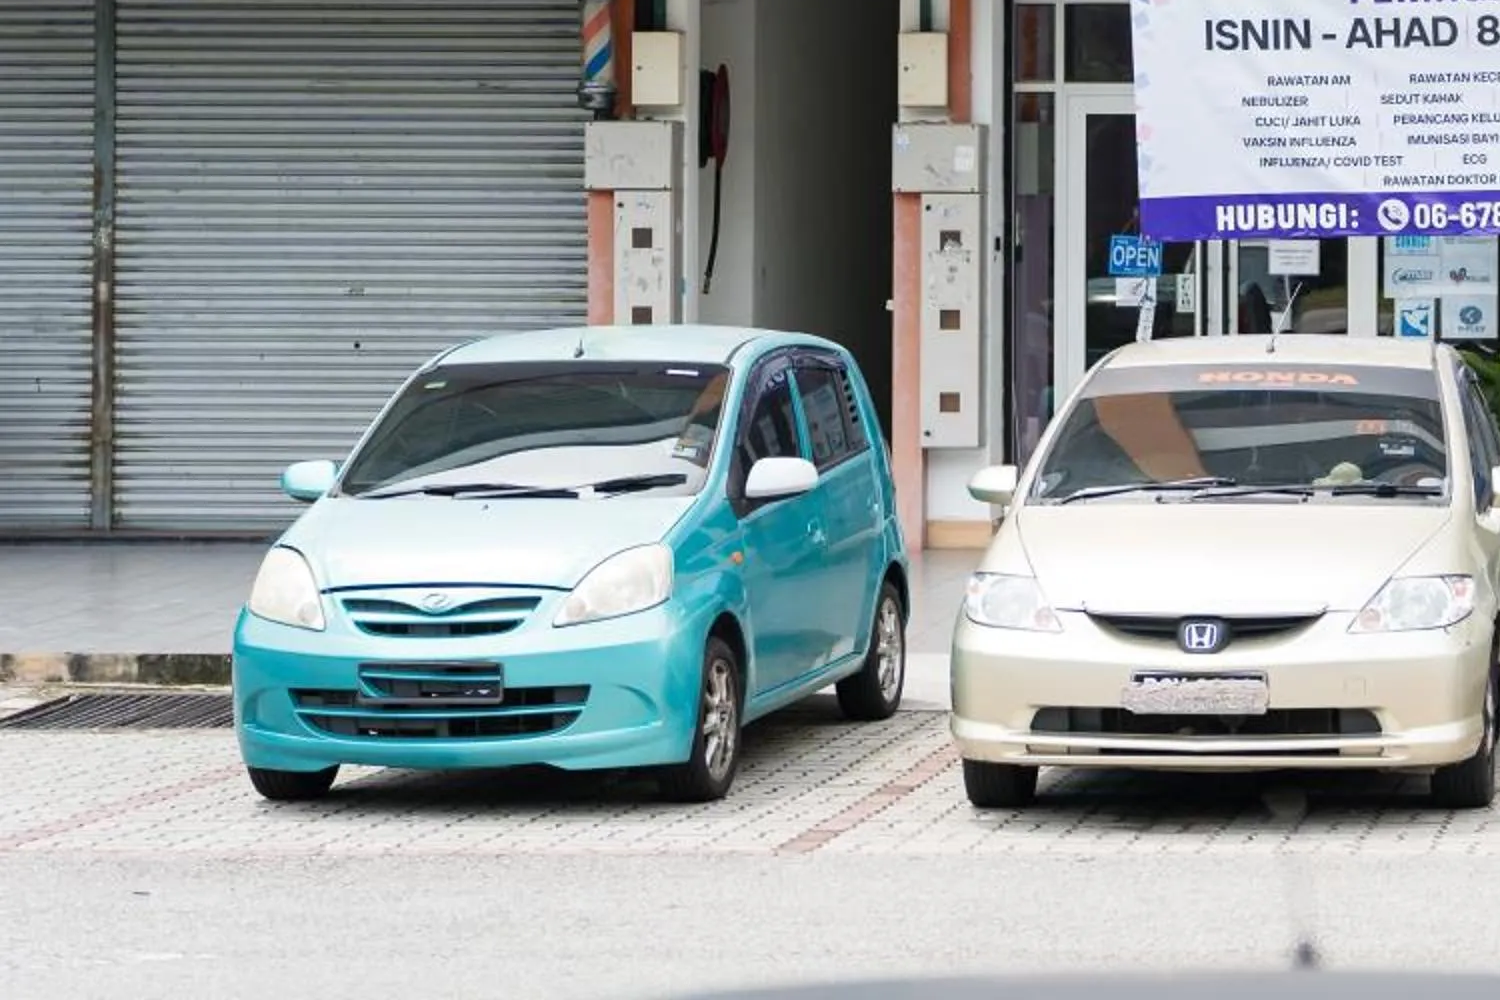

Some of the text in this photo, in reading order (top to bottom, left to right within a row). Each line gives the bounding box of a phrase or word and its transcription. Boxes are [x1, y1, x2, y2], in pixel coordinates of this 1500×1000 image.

[1204, 18, 1313, 51] ISNIN
[1345, 15, 1459, 49] AHAD
[1267, 75, 1351, 87] RAWATAN AM
[1409, 73, 1471, 84] RAWATAN
[1241, 96, 1309, 107] NEBULIZER
[1380, 93, 1464, 105] SEDUT KAHAK
[1292, 116, 1328, 127] JAHIT
[1330, 115, 1361, 127] LUKA
[1393, 112, 1469, 125] PERANCANG
[1243, 136, 1357, 148] VAKSIN INFLUENZA
[1407, 133, 1499, 145] IMUNISASI BAYI
[1333, 156, 1372, 167] COVID
[1374, 155, 1404, 167] TEST
[1463, 154, 1488, 165] ECG
[1383, 175, 1445, 187] RAWATAN
[1447, 173, 1497, 185] DOKTOR
[1216, 203, 1360, 232] HUBUNGI:
[1112, 244, 1160, 268] OPEN
[1199, 371, 1359, 385] HONDA
